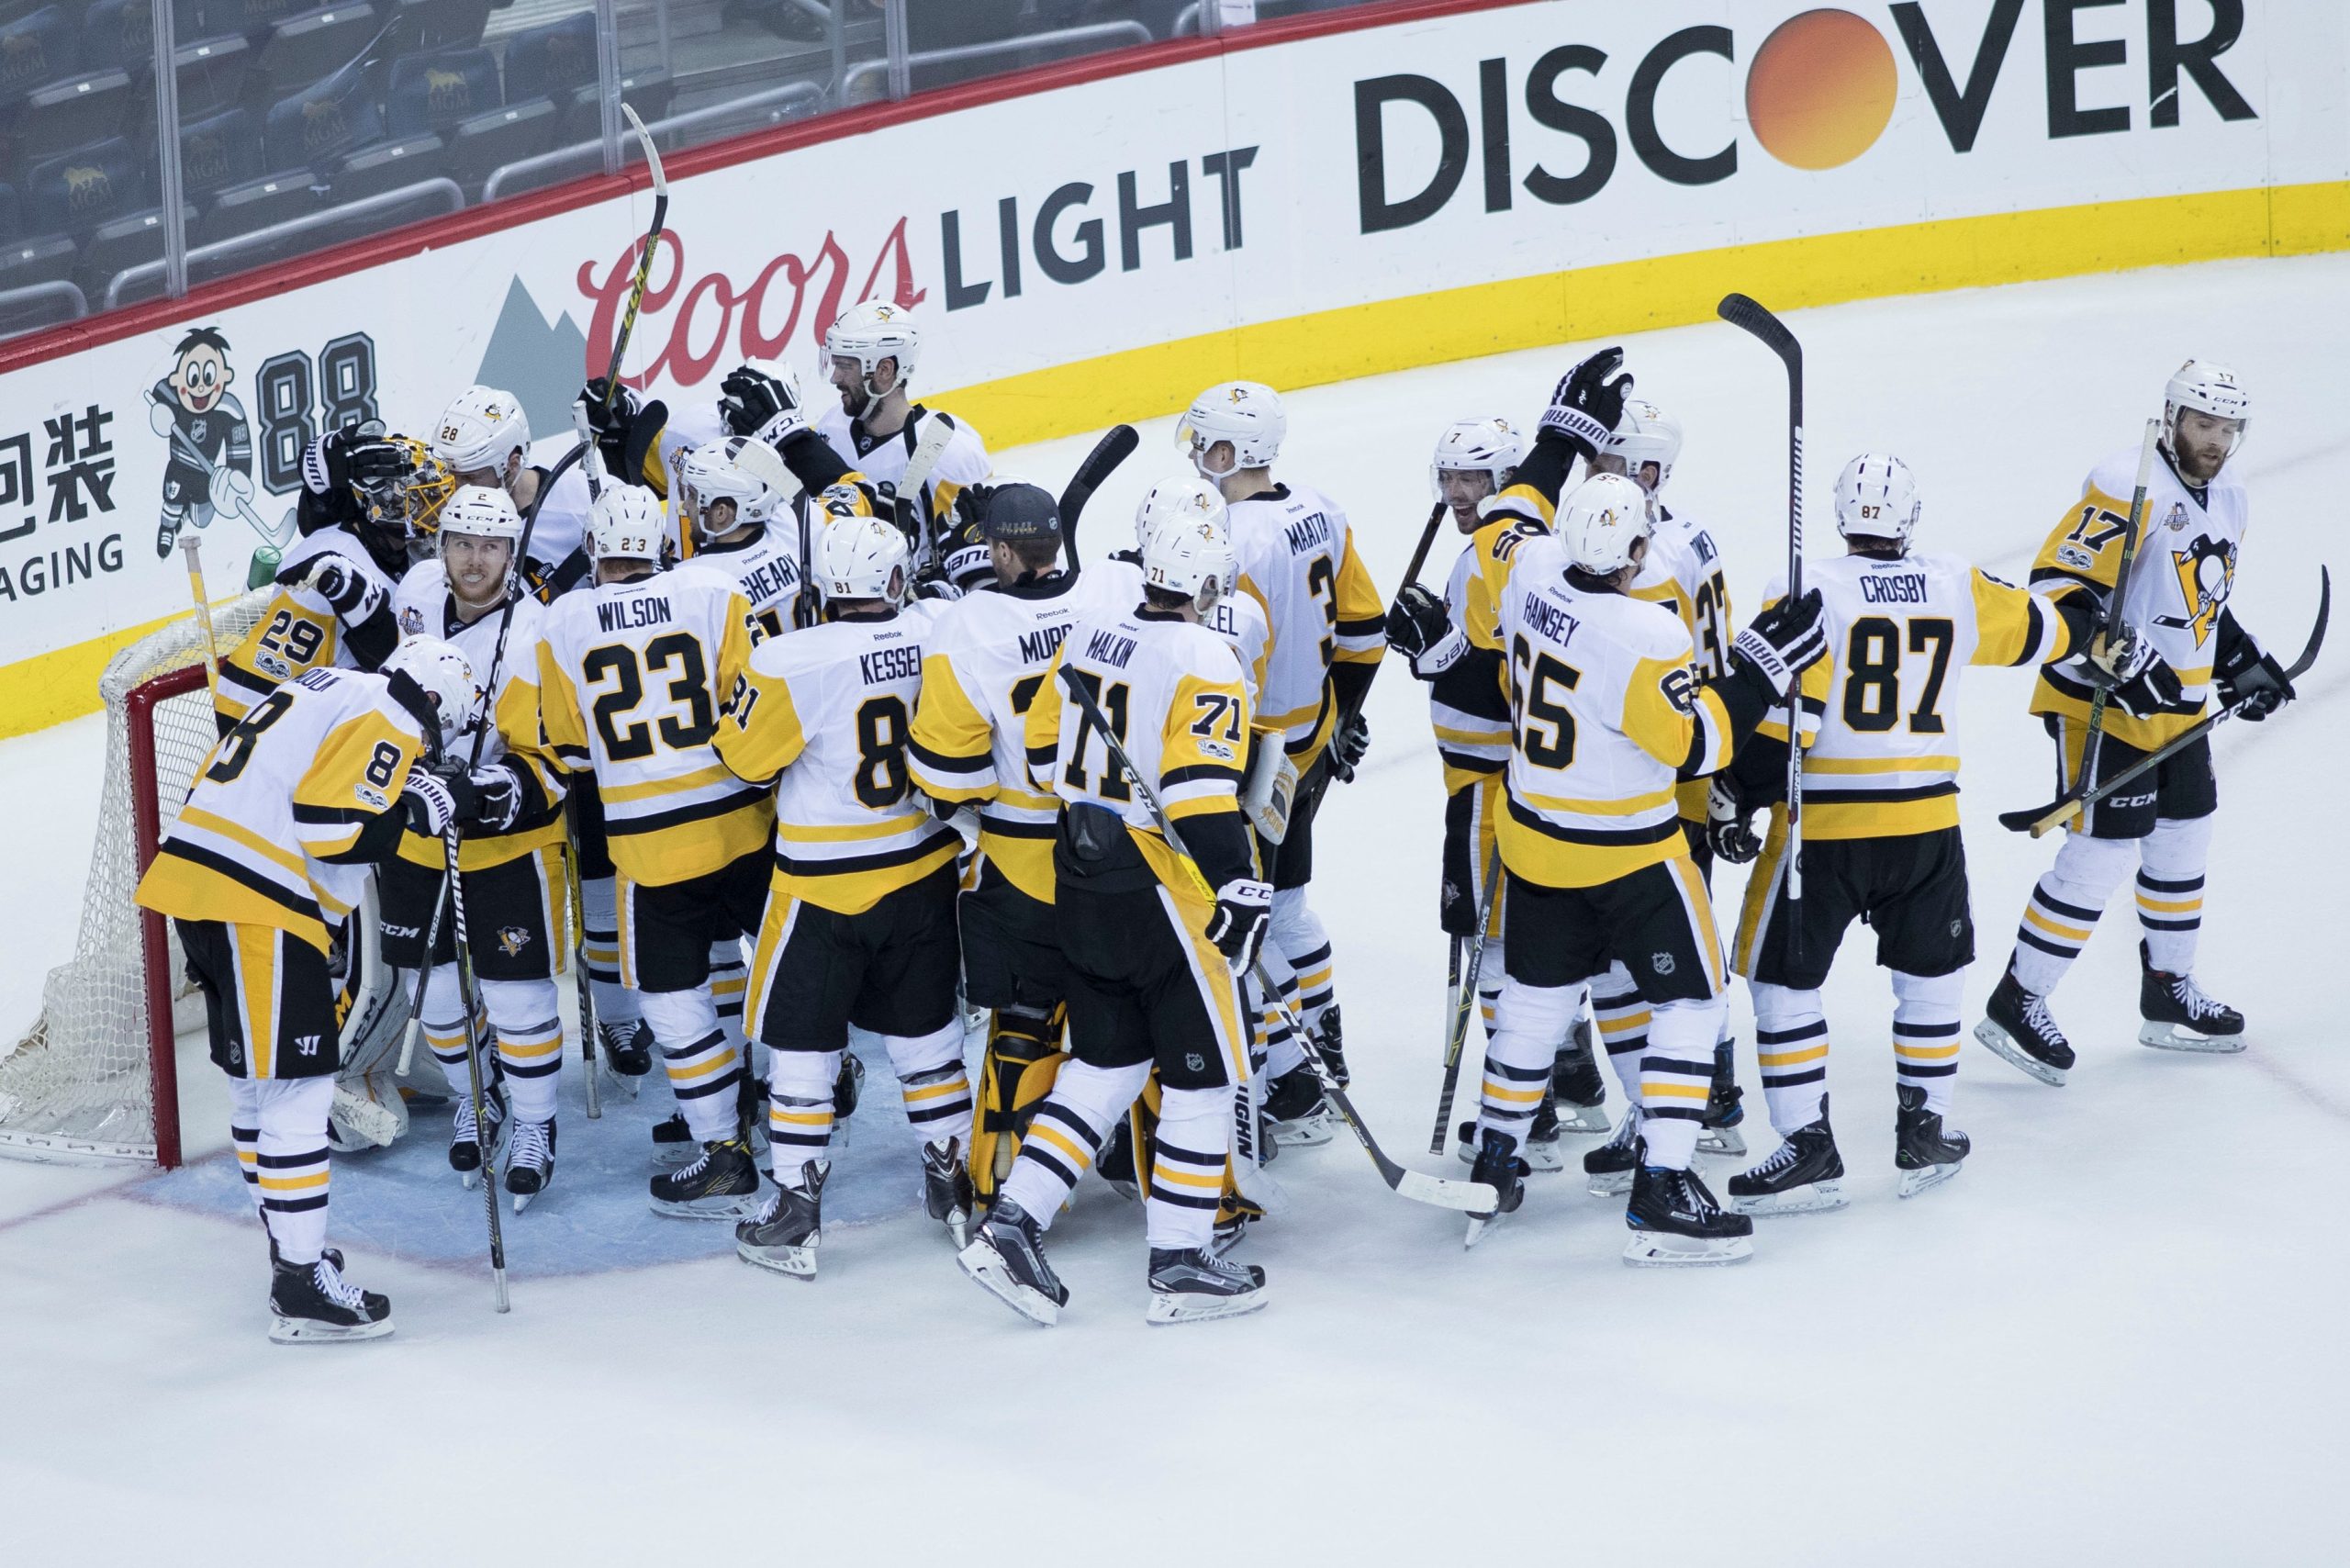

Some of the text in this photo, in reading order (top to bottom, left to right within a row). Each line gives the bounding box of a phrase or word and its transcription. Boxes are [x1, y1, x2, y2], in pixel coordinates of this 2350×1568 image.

[428, 90, 471, 112] MGM
[576, 145, 1259, 389] Coors LIGHT
[256, 331, 378, 497] 88
[2213, 396, 2238, 406] CCM
[441, 425, 458, 442] 28
[1449, 432, 1461, 443] 7
[1541, 409, 1608, 444] WARRIO
[477, 493, 487, 501] 2
[1794, 440, 1803, 551] WARRIOR
[1861, 505, 1881, 521] 87
[465, 514, 494, 522] CCM
[1284, 511, 1328, 556] MAATTA
[2066, 506, 2130, 553] 17
[621, 537, 646, 552] 23
[741, 548, 770, 566] Reebok
[508, 572, 518, 601] CCM
[834, 581, 852, 594] 81
[1151, 566, 1164, 584] 71
[1859, 573, 1928, 603] CROSBY
[597, 597, 671, 633] WILSON
[1036, 608, 1069, 621] Reebok
[1523, 591, 1580, 648] HAINSEY
[258, 609, 325, 666] 29
[873, 631, 903, 641] Reebok
[1085, 629, 1138, 669] MALKIN
[1841, 615, 1954, 734] 87
[581, 632, 715, 764] 23
[727, 670, 760, 733] 81
[1512, 632, 1583, 771] 65
[2213, 691, 2261, 728] CCM
[1063, 666, 1132, 803] 71
[1190, 694, 1241, 743] 71
[205, 690, 297, 785] 8
[365, 739, 402, 789] 8
[1123, 766, 1158, 813] CCM
[2109, 791, 2157, 808] CCM
[1237, 885, 1272, 901] CC
[380, 921, 420, 938] CCM
[429, 915, 441, 944] CCM
[1475, 904, 1491, 951] TACKS
[340, 995, 379, 1072] CCM
[1271, 1002, 1341, 1090] CCM
